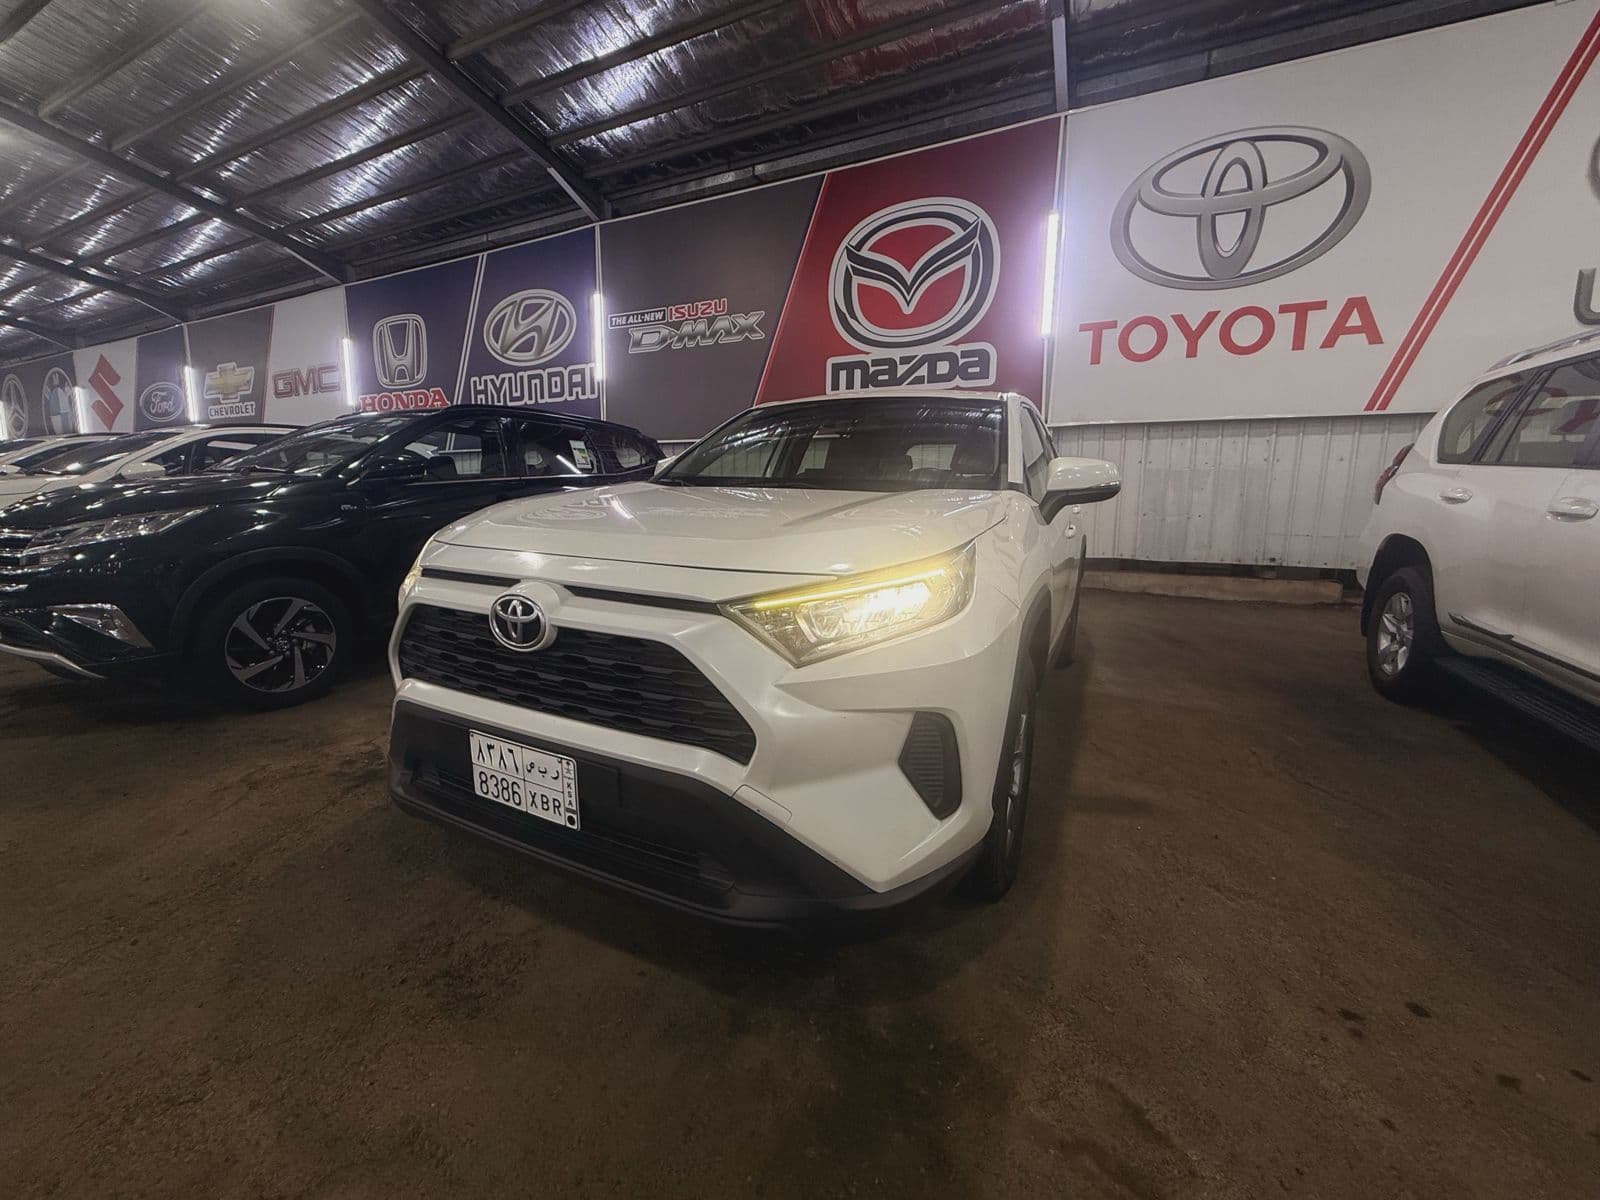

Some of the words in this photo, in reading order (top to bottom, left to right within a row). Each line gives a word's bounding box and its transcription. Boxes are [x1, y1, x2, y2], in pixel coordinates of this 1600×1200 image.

[611, 317, 627, 326] THE
[628, 311, 664, 323] ALL-NEW
[668, 298, 727, 321] ISUZU
[629, 312, 765, 353] D-MAX
[1079, 296, 1384, 365] TOYOTA
[273, 364, 341, 398] GMC
[150, 391, 176, 414] Ford
[208, 403, 255, 418] CHEVROLET
[360, 388, 450, 411] HONDA
[479, 771, 521, 806] 8386
[529, 790, 561, 816] XBR
